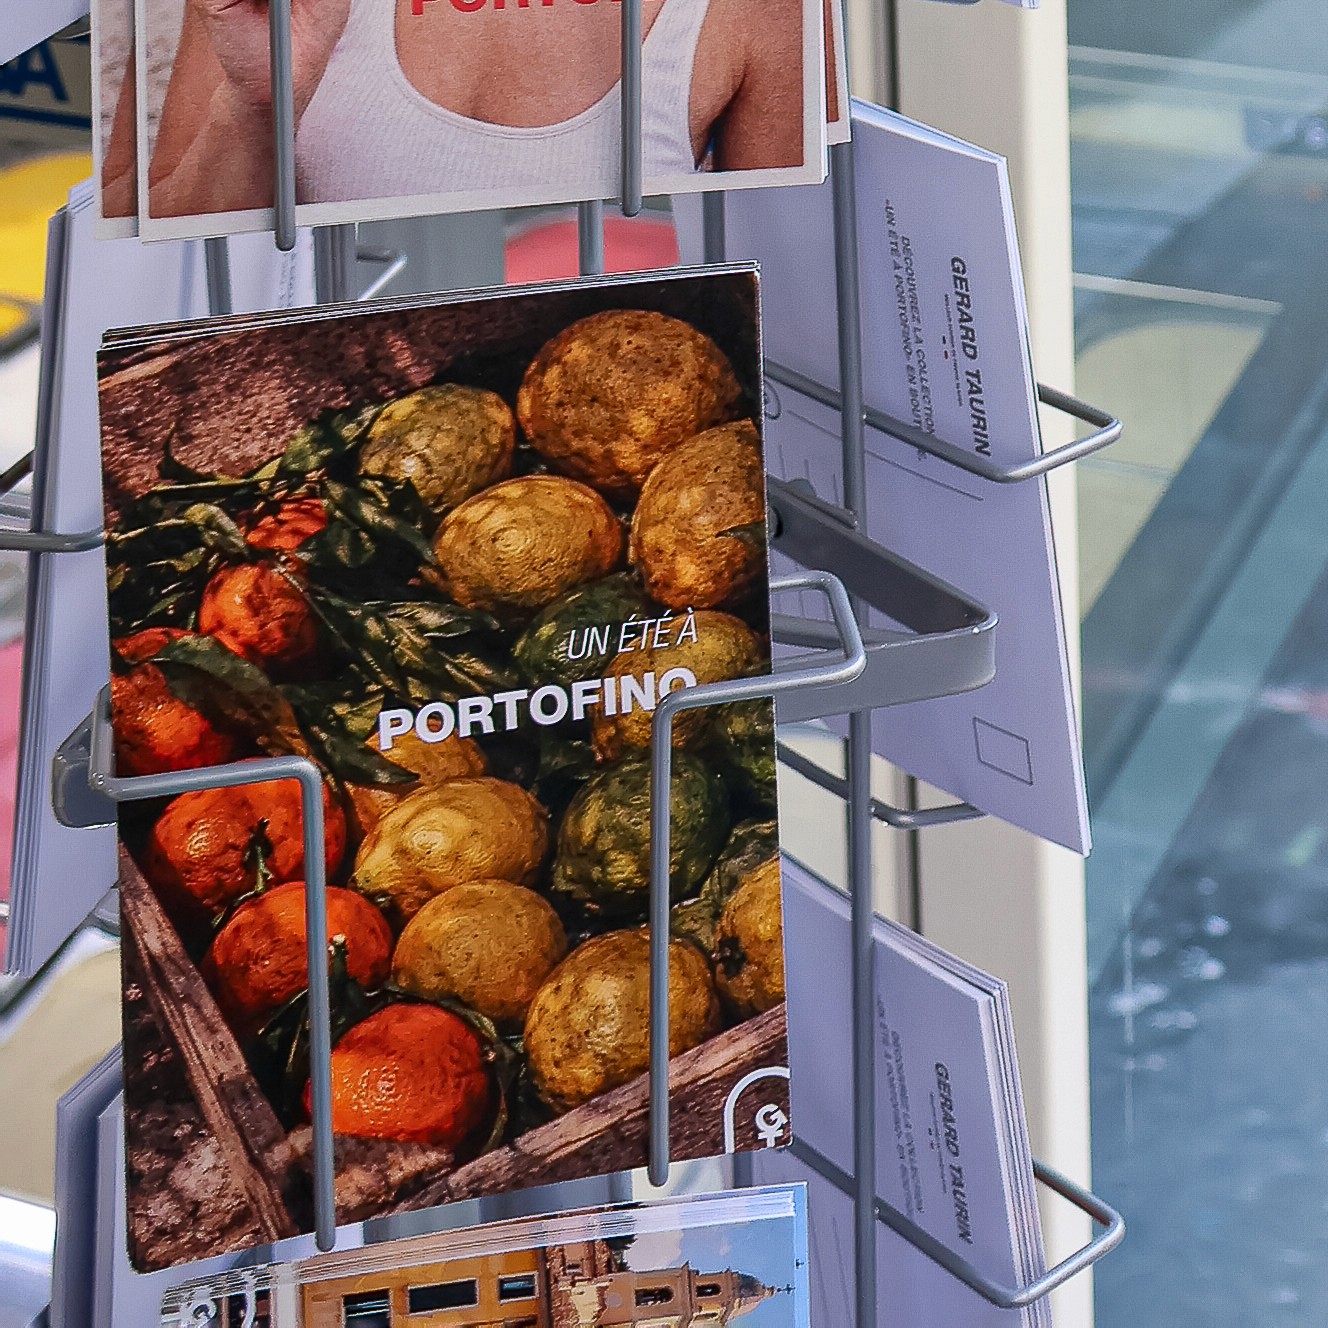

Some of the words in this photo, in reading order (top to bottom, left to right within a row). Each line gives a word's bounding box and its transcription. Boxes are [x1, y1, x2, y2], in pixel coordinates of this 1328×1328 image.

[951, 257, 977, 360] GERARD
[965, 369, 992, 457] TAURIN
[567, 625, 610, 661] UN
[618, 610, 674, 654] ÉTÉ
[677, 605, 698, 646] À
[935, 1063, 960, 1157] GERARD
